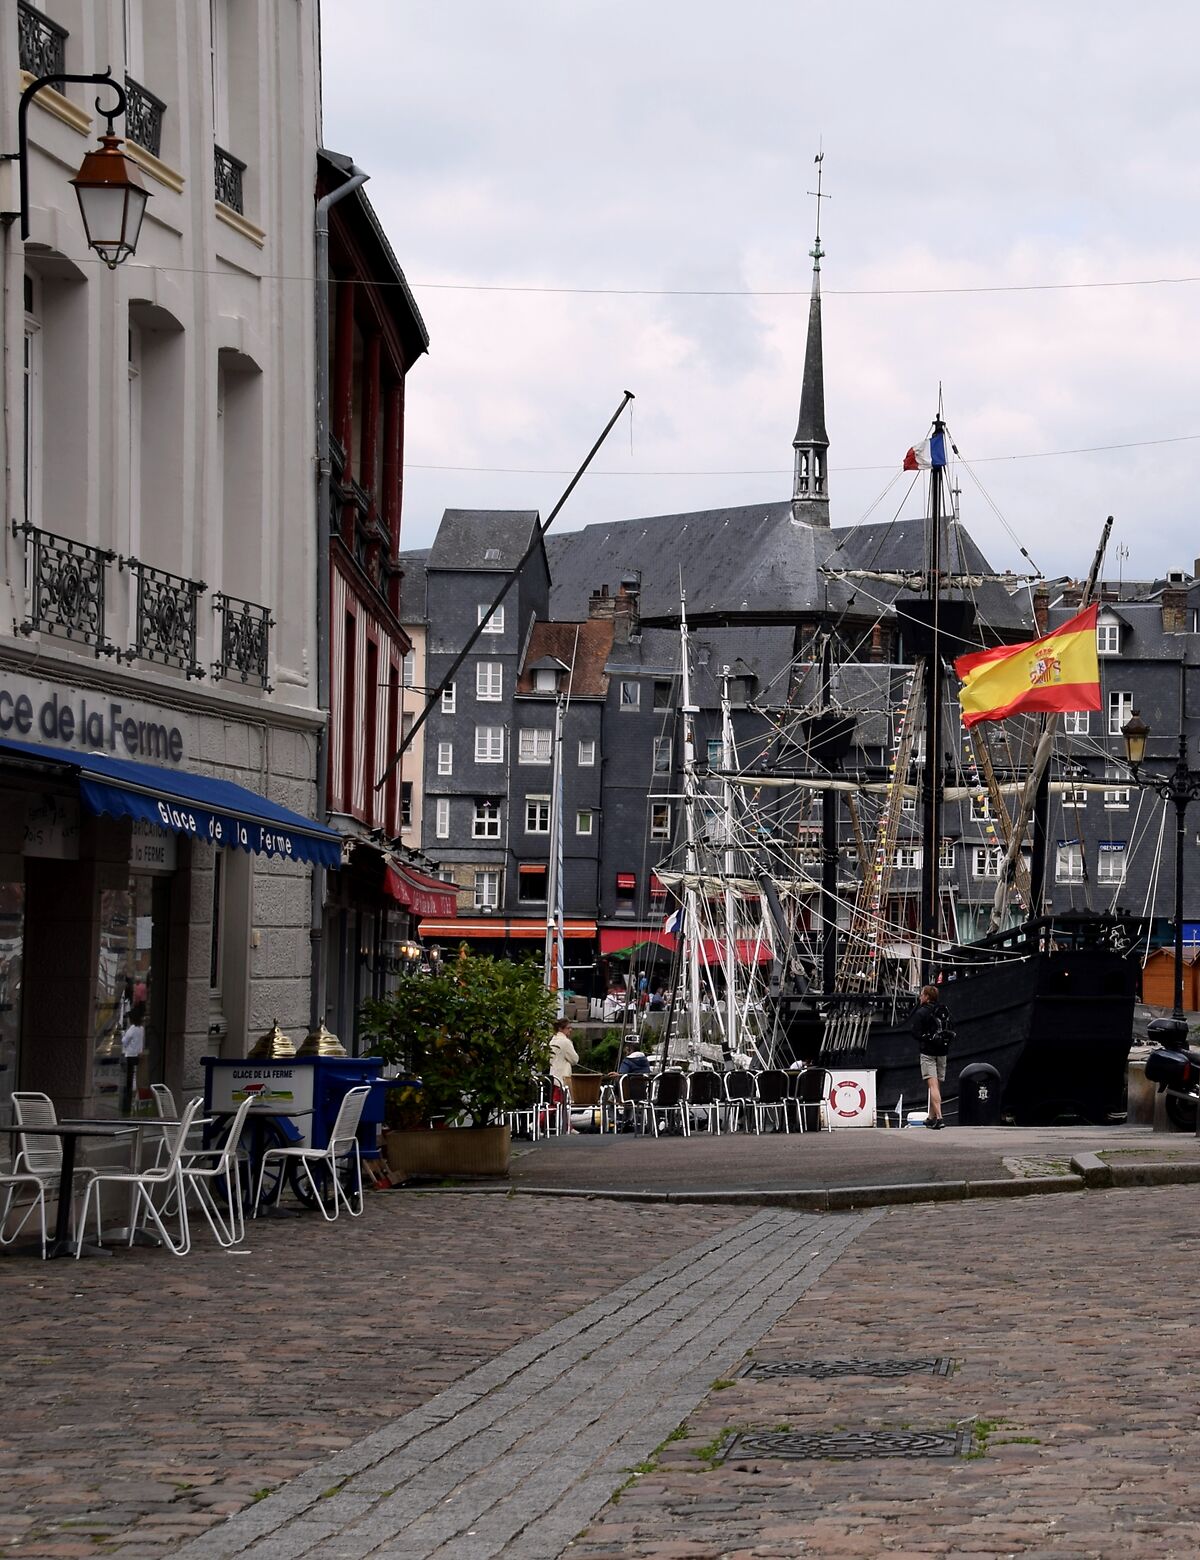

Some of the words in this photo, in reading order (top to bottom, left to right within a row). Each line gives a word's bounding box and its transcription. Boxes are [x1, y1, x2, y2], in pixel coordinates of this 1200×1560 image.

[40, 692, 75, 742] de
[82, 699, 104, 748] la
[110, 703, 183, 762] Ferme
[157, 801, 197, 832] Glace
[208, 815, 222, 839] de
[236, 821, 248, 845] la
[260, 827, 292, 854] Ferme
[144, 845, 165, 863] FERME
[232, 1070, 252, 1079] GLACE
[254, 1070, 262, 1079] DE
[263, 1070, 271, 1078] LA
[272, 1069, 293, 1079] FERME
